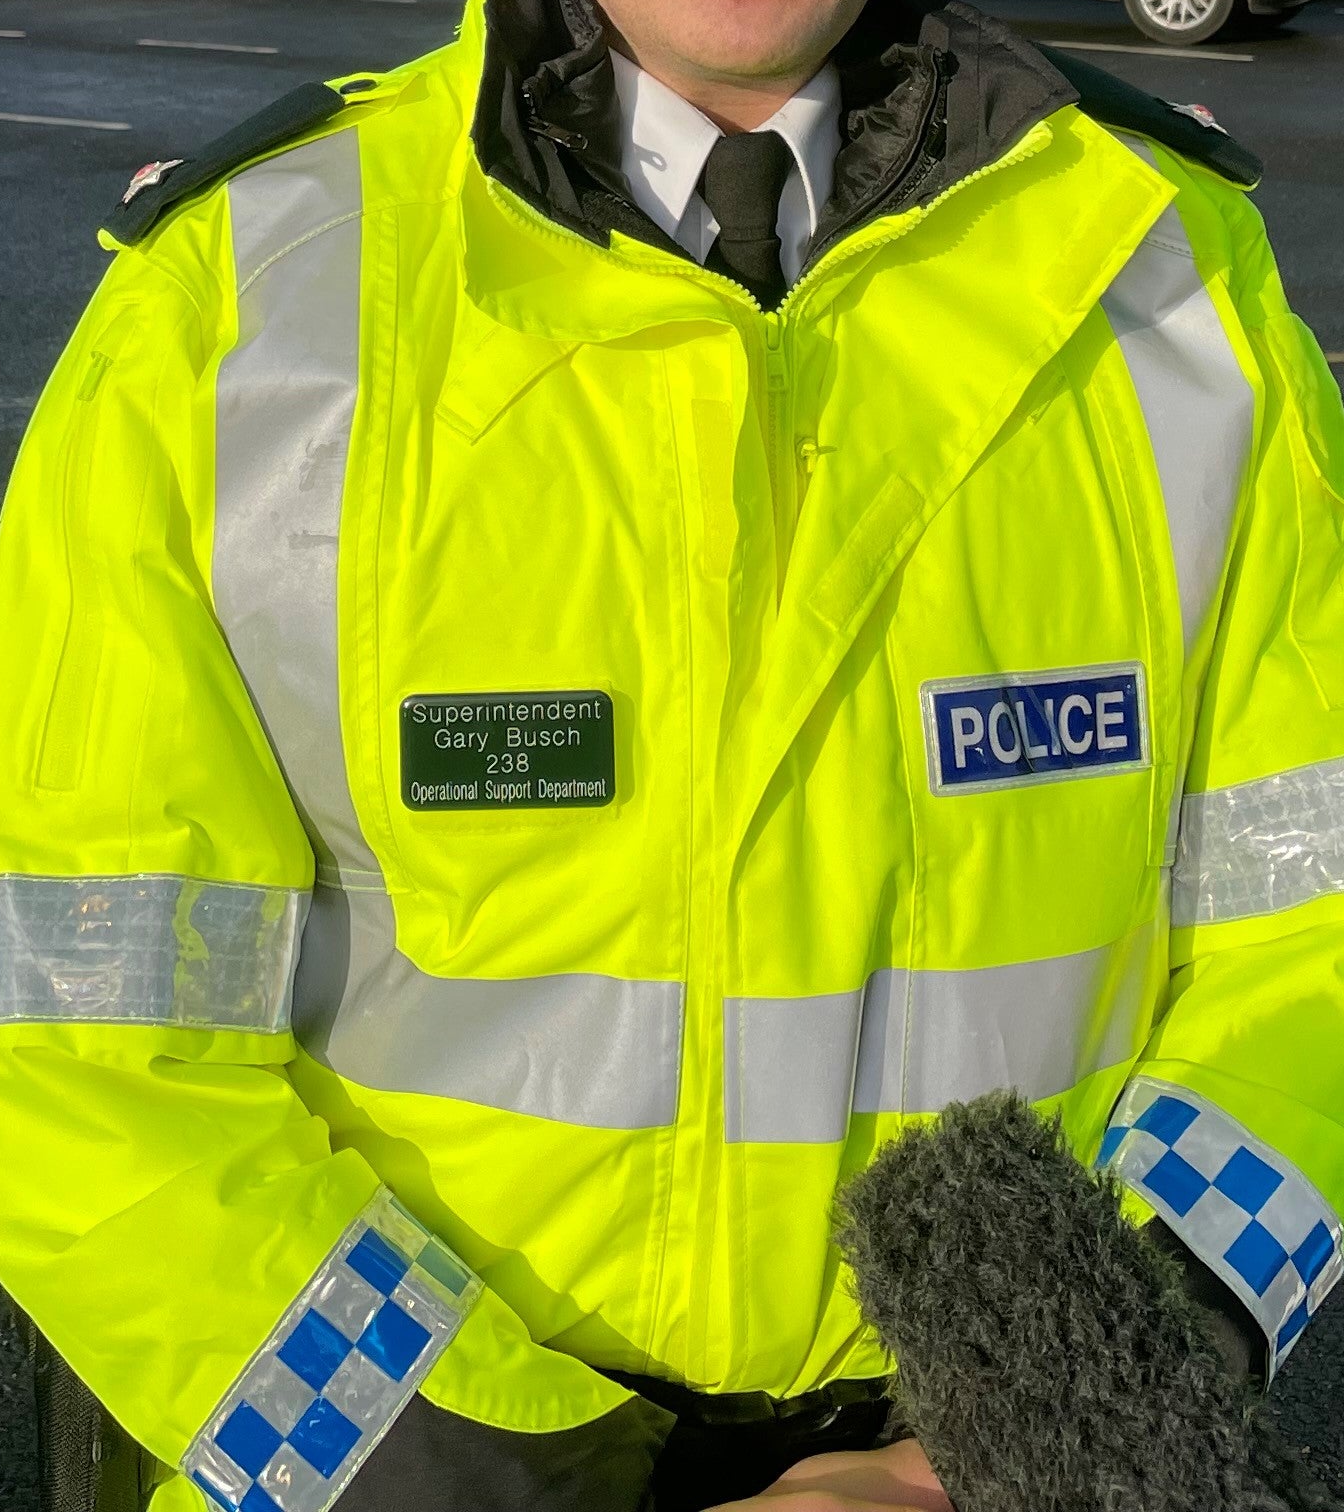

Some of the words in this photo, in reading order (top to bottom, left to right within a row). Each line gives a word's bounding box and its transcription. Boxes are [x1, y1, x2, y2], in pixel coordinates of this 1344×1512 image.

[413, 700, 601, 724] Superintendent
[434, 729, 489, 752] Gary
[507, 726, 581, 747] Busch
[950, 691, 1128, 769] POLICE
[486, 753, 530, 774] 238
[411, 781, 478, 804] Operational
[485, 780, 532, 803] Support
[538, 778, 607, 802] Department
